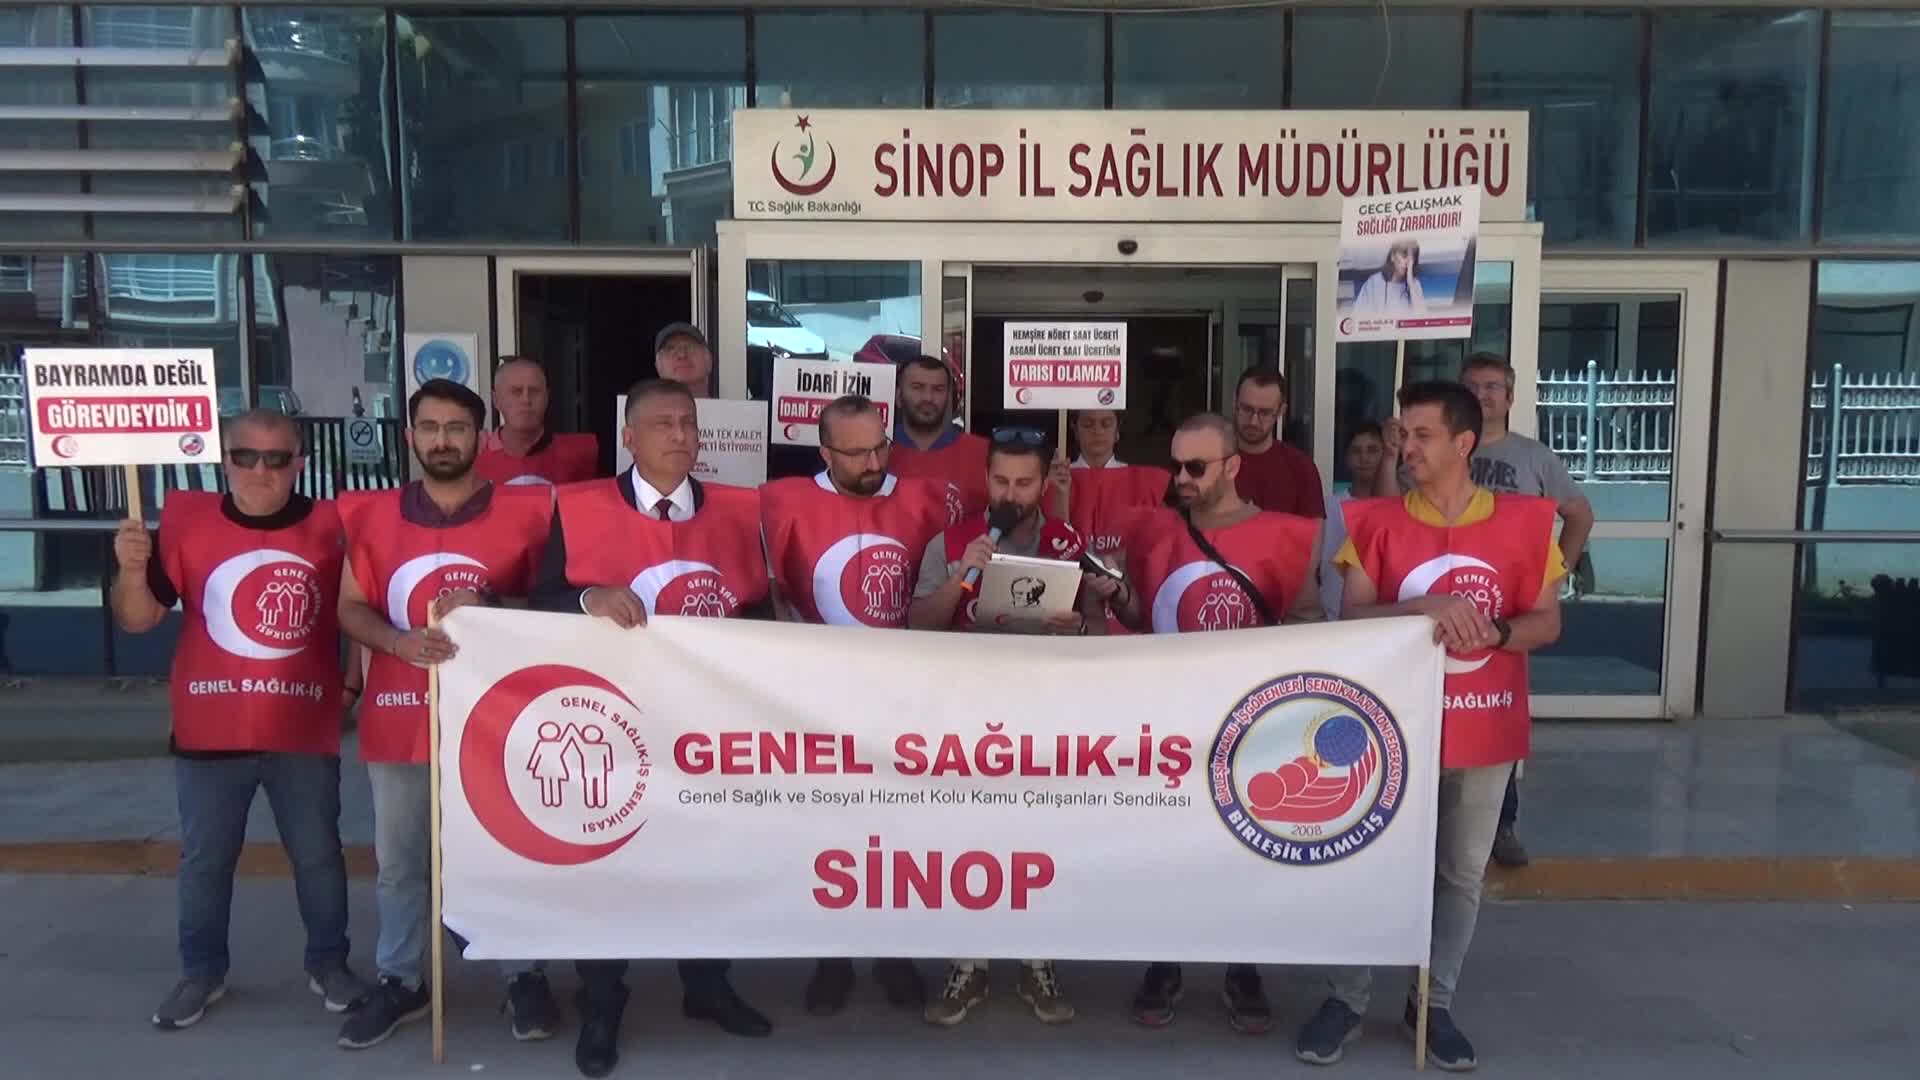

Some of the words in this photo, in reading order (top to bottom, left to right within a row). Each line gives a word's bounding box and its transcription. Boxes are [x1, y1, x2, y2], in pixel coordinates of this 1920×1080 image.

[873, 127, 1005, 198] SİNOP
[1018, 127, 1056, 198] İL
[1067, 127, 1225, 198] SAĞLIK
[1238, 127, 1510, 198] MÜDÜRLÜĞÜ
[768, 200, 804, 215] Sağlık
[807, 200, 862, 215] Bakanlığı
[1358, 202, 1393, 216] GECE
[1395, 195, 1463, 213] ÇALIŞMAK
[1356, 215, 1398, 236] SAĞLIĞA
[1400, 211, 1462, 233] ZARARLIDIR!
[1012, 328, 1045, 343] HEMŞİRE
[1048, 328, 1071, 341] NÖBET
[1073, 330, 1091, 341] SAAT
[1094, 328, 1119, 341] ÜCRETİ
[1009, 344, 1036, 356] ASGARİ
[1038, 344, 1061, 356] ÜCRET
[1063, 346, 1081, 356] SAAT
[34, 363, 148, 387] BAYRAMDA
[153, 358, 207, 386] DEĞİL
[796, 367, 838, 394] İDARİ
[842, 370, 872, 396] İZİN
[1012, 364, 1054, 382] YARISI
[1057, 364, 1111, 382] OLAMAZ
[47, 398, 191, 429] GÖREVDEYDİK
[780, 400, 809, 418] İDARİ
[717, 430, 732, 439] TEK
[734, 430, 762, 440] KALEM
[188, 679, 238, 695] GENEL
[241, 676, 324, 702] SAĞLIK-İŞ
[376, 691, 421, 707] GENEL
[560, 696, 607, 717] GENEL
[610, 713, 652, 777] SAĞLIK-İŞ
[673, 731, 874, 776] GENEL
[893, 721, 1193, 789] SAĞLIK-İŞ
[582, 782, 646, 833] SENDİKASI
[678, 788, 727, 804] Genel
[732, 788, 782, 807] Sağlık
[787, 792, 806, 804] ve
[811, 789, 864, 807] Sosyal
[869, 789, 924, 804] Hizmet
[930, 789, 966, 804] Kolu
[971, 790, 1017, 805] Kamu
[1023, 789, 1107, 808] Çalışanları
[1112, 791, 1192, 807] Sendikası
[1227, 810, 1303, 861] BİRLEŞİK
[1309, 811, 1385, 862] KAMU-İŞ
[812, 834, 1055, 911] SİNOP
